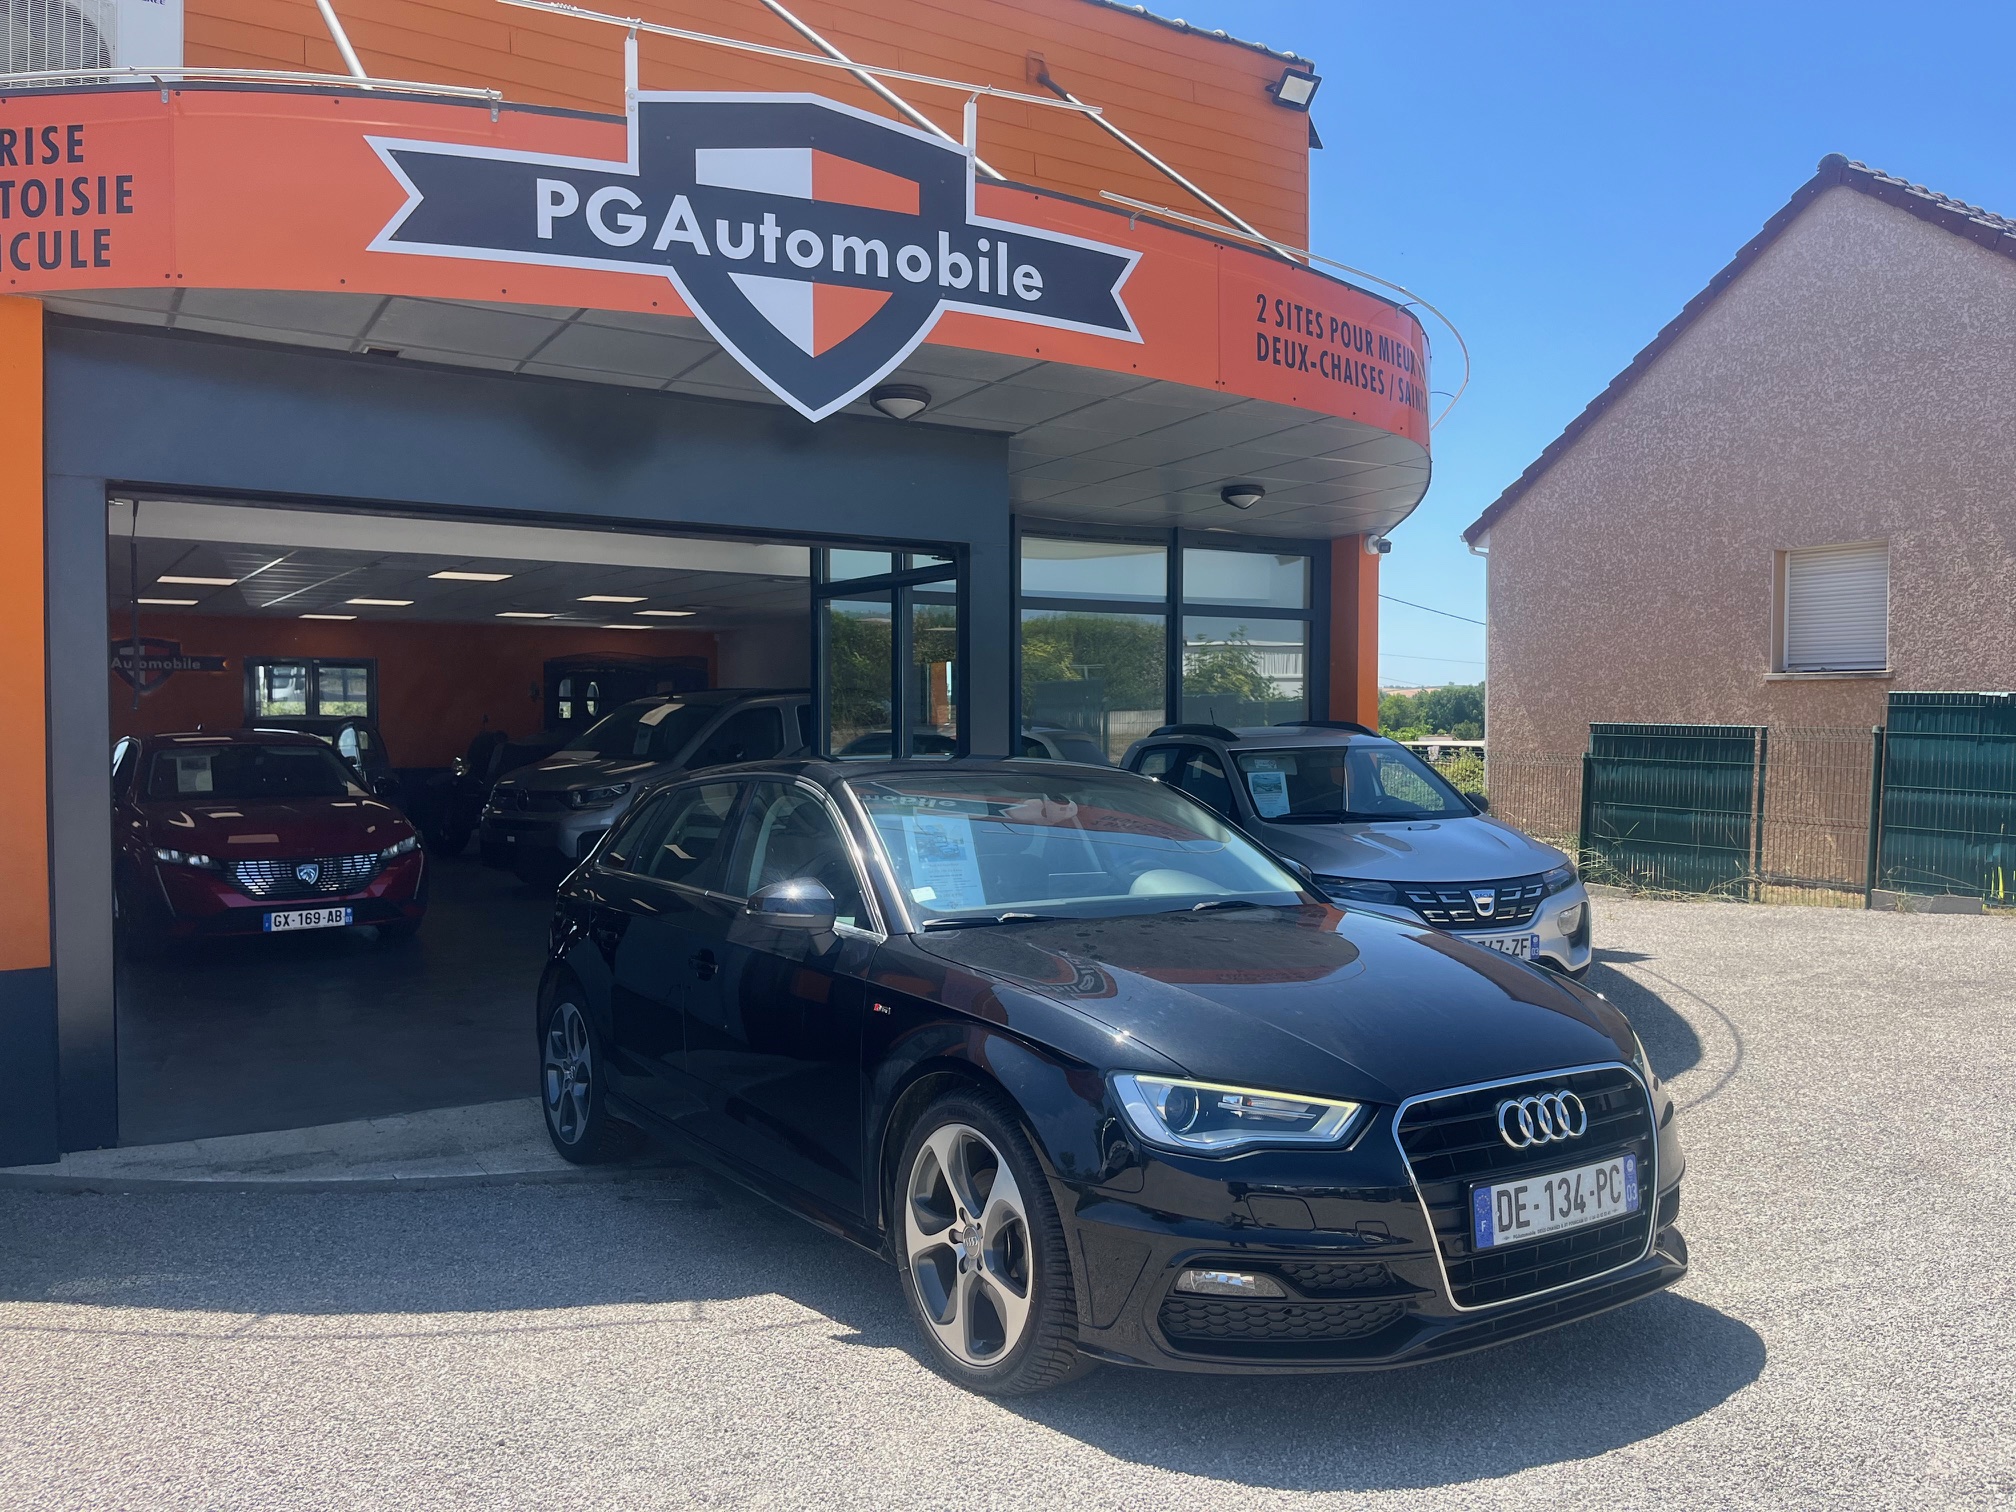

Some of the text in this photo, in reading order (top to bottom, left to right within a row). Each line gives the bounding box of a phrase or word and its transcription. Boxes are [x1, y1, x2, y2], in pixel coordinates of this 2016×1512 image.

[0, 175, 133, 219] TOISIE
[0, 229, 111, 271] CULE
[536, 178, 1043, 301] PGAutomobile
[1256, 293, 1267, 323] 2
[1275, 298, 1324, 340] SITES
[1330, 316, 1374, 357] POUR
[1379, 334, 1416, 377] MIEUX
[1256, 332, 1385, 395] DEUX-CHAISES
[110, 657, 201, 670] Auomobile
[273, 909, 343, 928] GX-169-AB
[1481, 1220, 1487, 1233] F
[1496, 1164, 1622, 1233] DE-134-PC
[1626, 1182, 1637, 1203] 03
